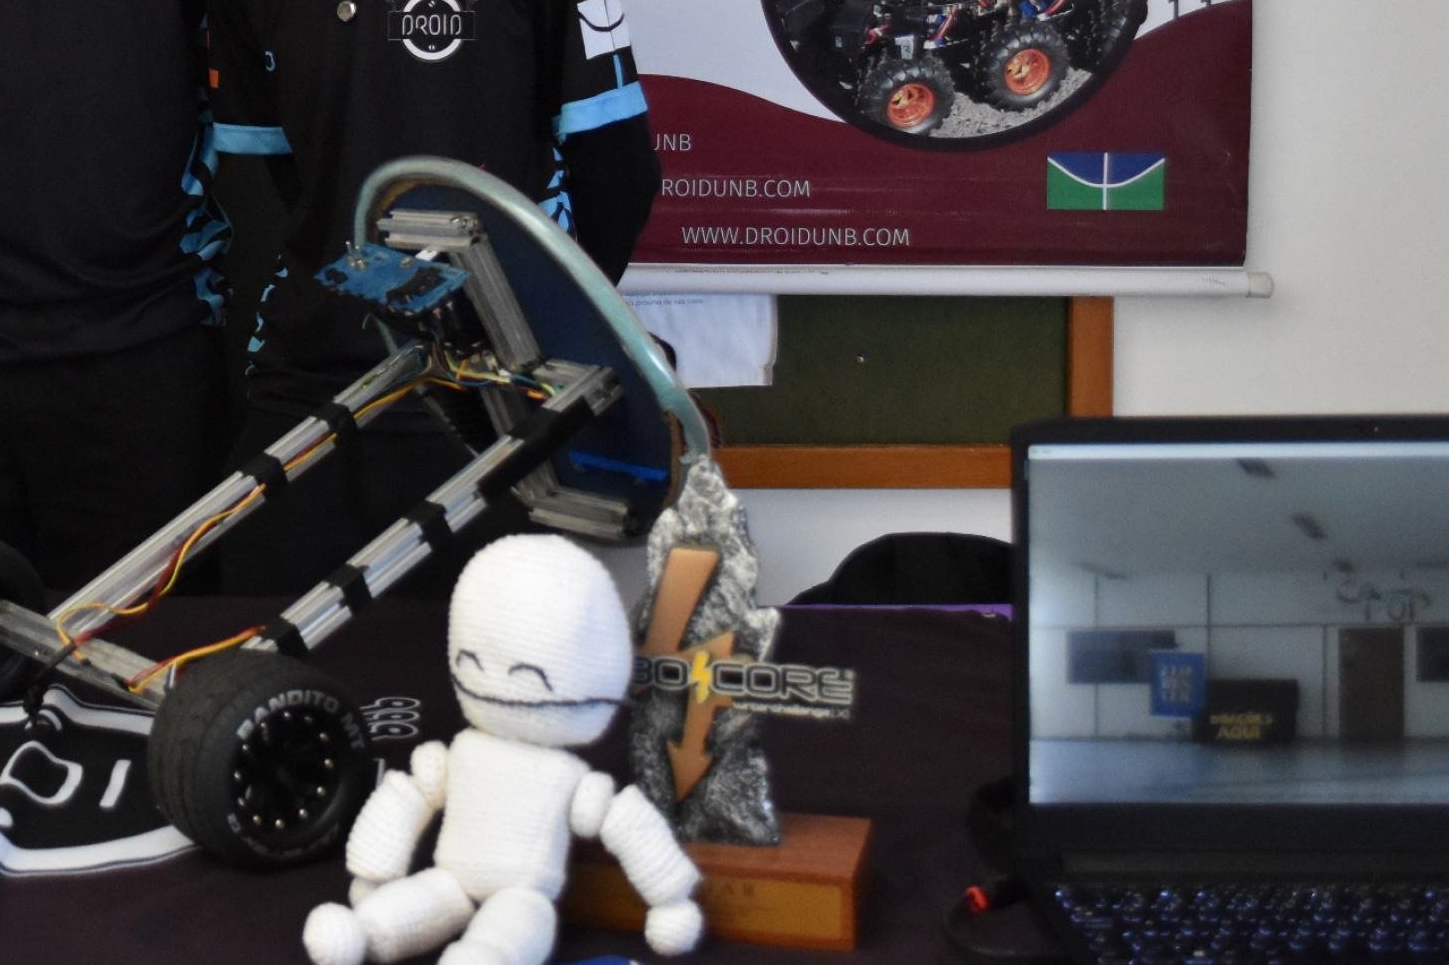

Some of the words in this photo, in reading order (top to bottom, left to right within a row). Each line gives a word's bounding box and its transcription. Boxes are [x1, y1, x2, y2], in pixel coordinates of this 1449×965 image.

[402, 14, 462, 36] DROID
[661, 178, 812, 198] ROIDUNB.COM
[681, 226, 910, 247] WWW.DROIDUNB.COM
